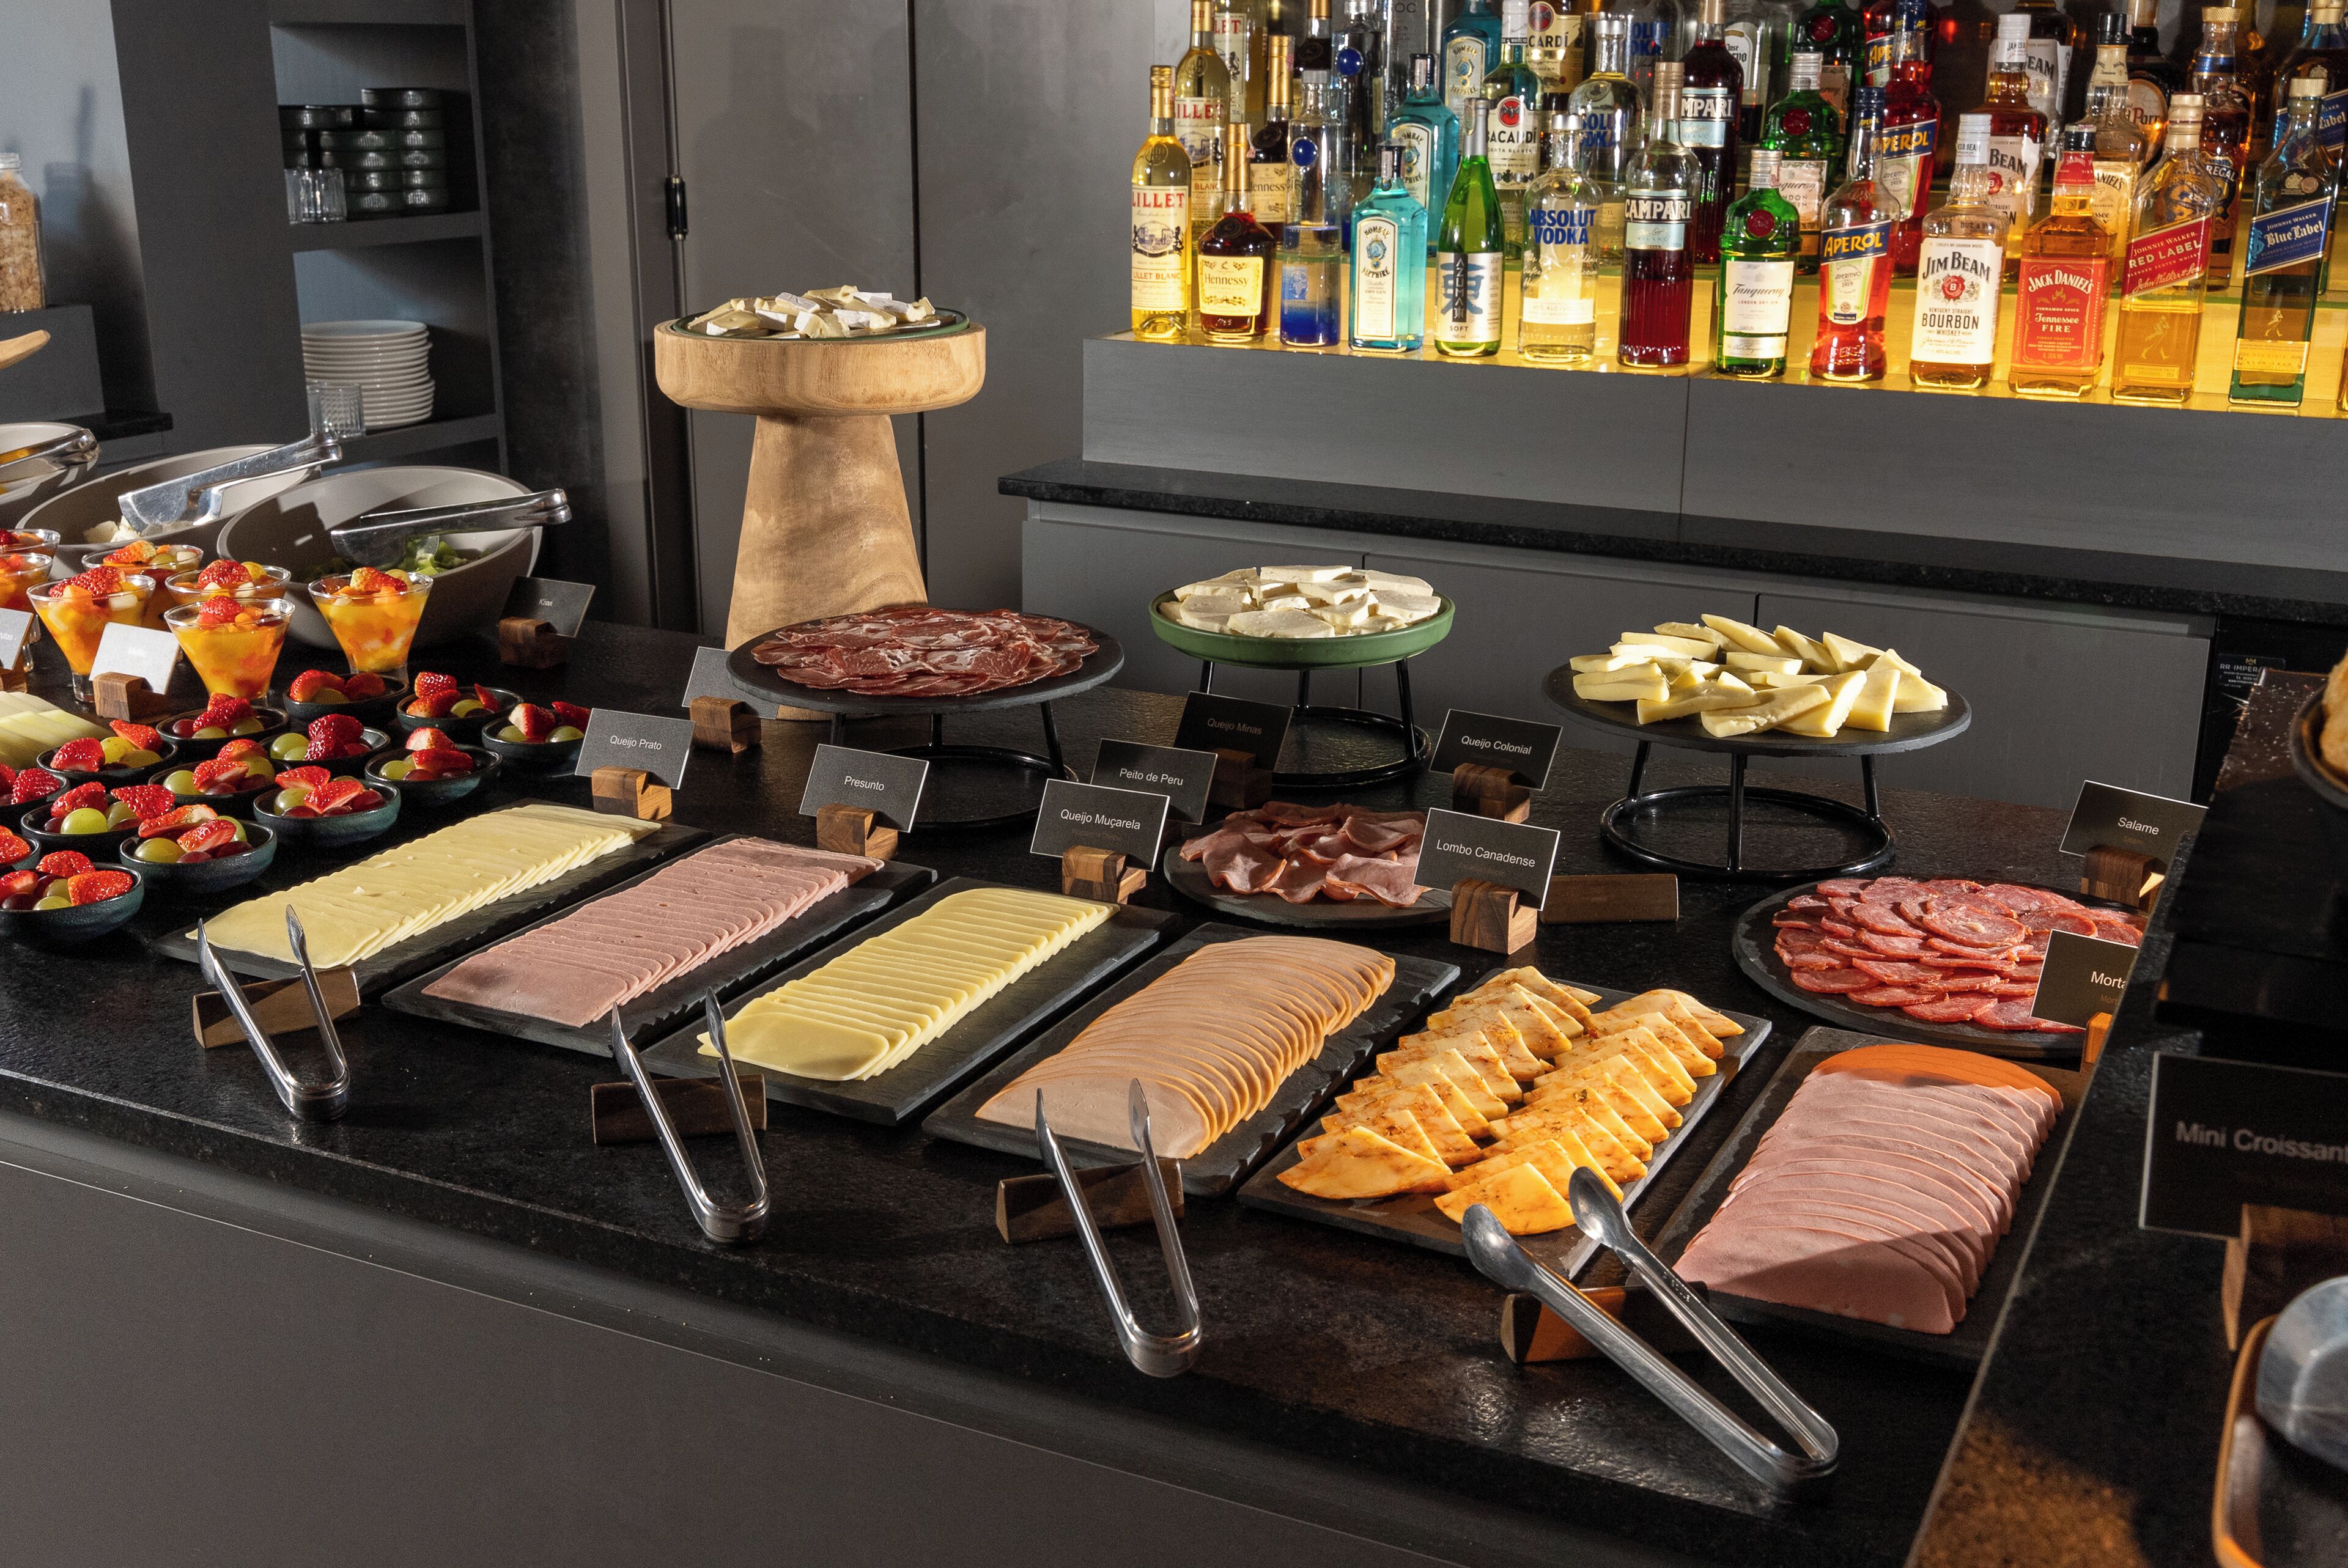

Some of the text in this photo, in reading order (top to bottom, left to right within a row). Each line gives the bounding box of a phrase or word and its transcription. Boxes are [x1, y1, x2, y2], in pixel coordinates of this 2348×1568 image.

[1214, 20, 1241, 34] LET
[1527, 32, 1568, 48] CARDÍ
[1453, 45, 1478, 56] BOMBAY
[1869, 43, 1892, 65] APE
[2027, 56, 2055, 81] EAM
[1450, 86, 1477, 96] SAPPHIRE
[1175, 105, 1224, 119] ILLET
[1682, 98, 1733, 118] MPARI
[1401, 131, 1423, 145] OMBAY
[1405, 174, 1423, 183] PHIRE
[2094, 172, 2125, 191] ANIEL'S
[2206, 164, 2236, 182] REGAL
[1781, 182, 1817, 191] queray
[1132, 193, 1184, 208] LILLET
[1625, 198, 1691, 221] CAMPARI
[1529, 209, 1597, 227] ABSOLUT
[2267, 212, 2317, 231] JOHNNIE WALKER
[1364, 226, 1390, 239] BOMBAY
[1534, 227, 1589, 245] VODKA
[2264, 220, 2324, 248] Blue Label
[1824, 232, 1883, 258] APEROL
[2133, 232, 2196, 256] JOHNNIE WALKER
[2128, 240, 2202, 269] RED LABEL
[1362, 267, 1390, 279] SAPPHIRE
[1922, 251, 1992, 284] JIM BEAM
[1205, 273, 1249, 287] Hennessy
[2028, 269, 2094, 294] JACK DANIEL'S
[1733, 283, 1785, 298] Tanqueray
[1922, 313, 1979, 329] BOURBON
[2034, 312, 2079, 324] Tennessee
[1207, 718, 1262, 735] Queijo Minas
[610, 735, 662, 750] Queijo Prato
[1461, 735, 1532, 755] Queijo Colonial
[844, 775, 885, 791] Presunto
[1120, 768, 1184, 786] Peito de Peru
[1060, 808, 1141, 830] Queijo Muçarela
[2117, 817, 2159, 835] Salame
[1436, 839, 1536, 868] Lombo Canadense
[2176, 1121, 2228, 1149] Mini
